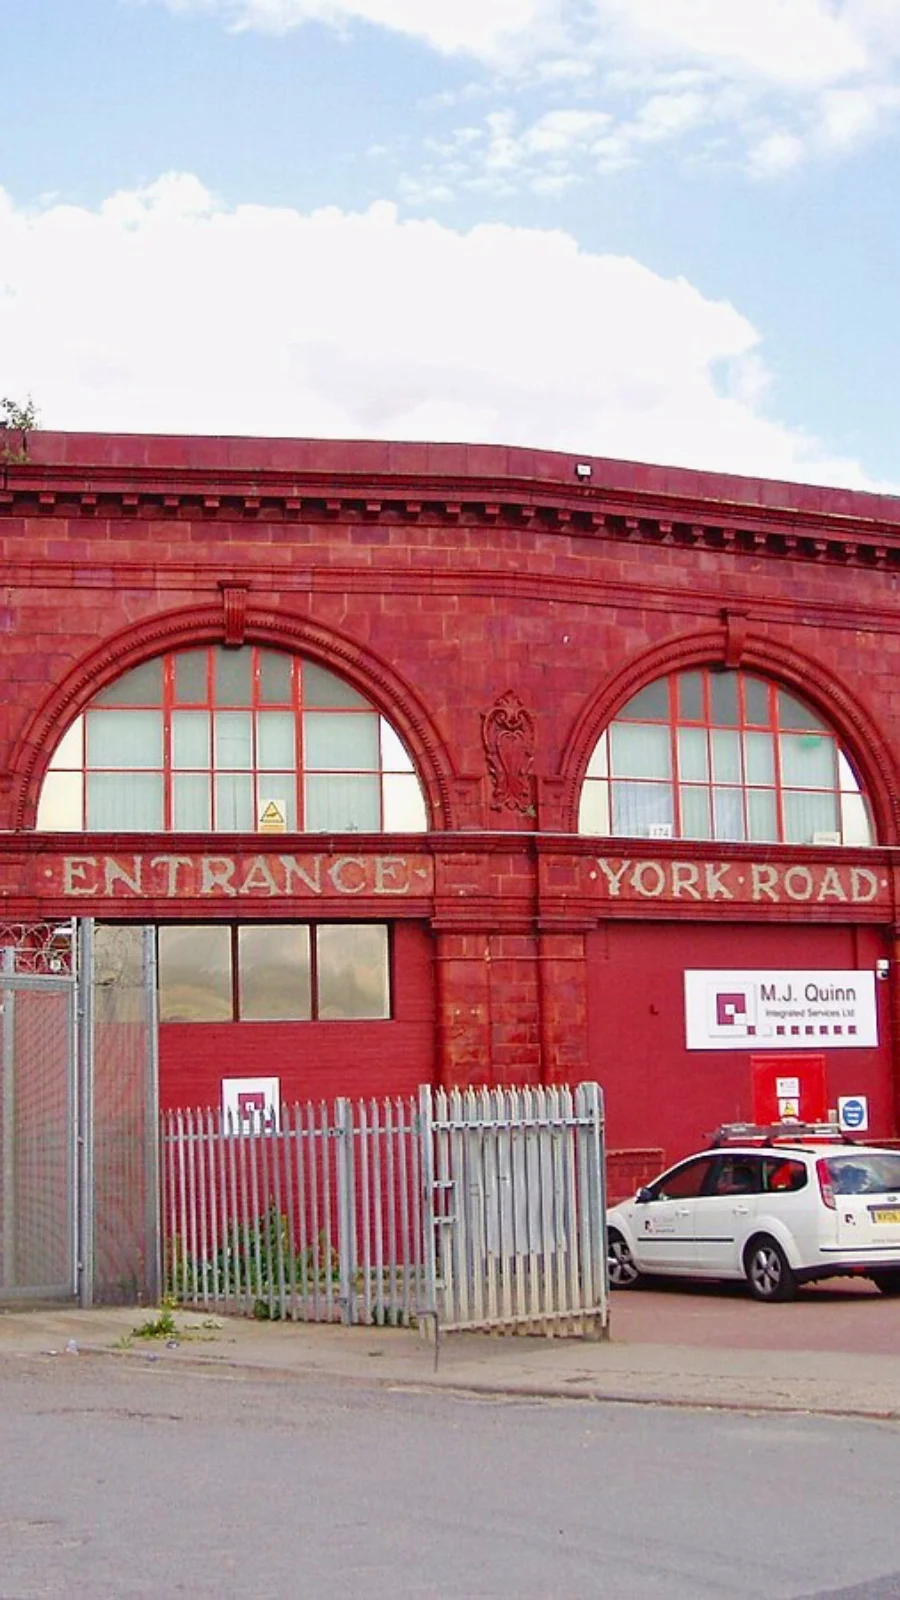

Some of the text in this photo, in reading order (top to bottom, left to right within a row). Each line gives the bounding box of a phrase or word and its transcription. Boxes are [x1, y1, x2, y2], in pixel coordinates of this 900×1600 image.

[62, 854, 410, 897] ENTRANCE
[597, 857, 878, 902] YORK ROAD
[760, 982, 856, 1002] M.J. Quinn
[766, 1008, 855, 1019] Integrated Services Ltd
